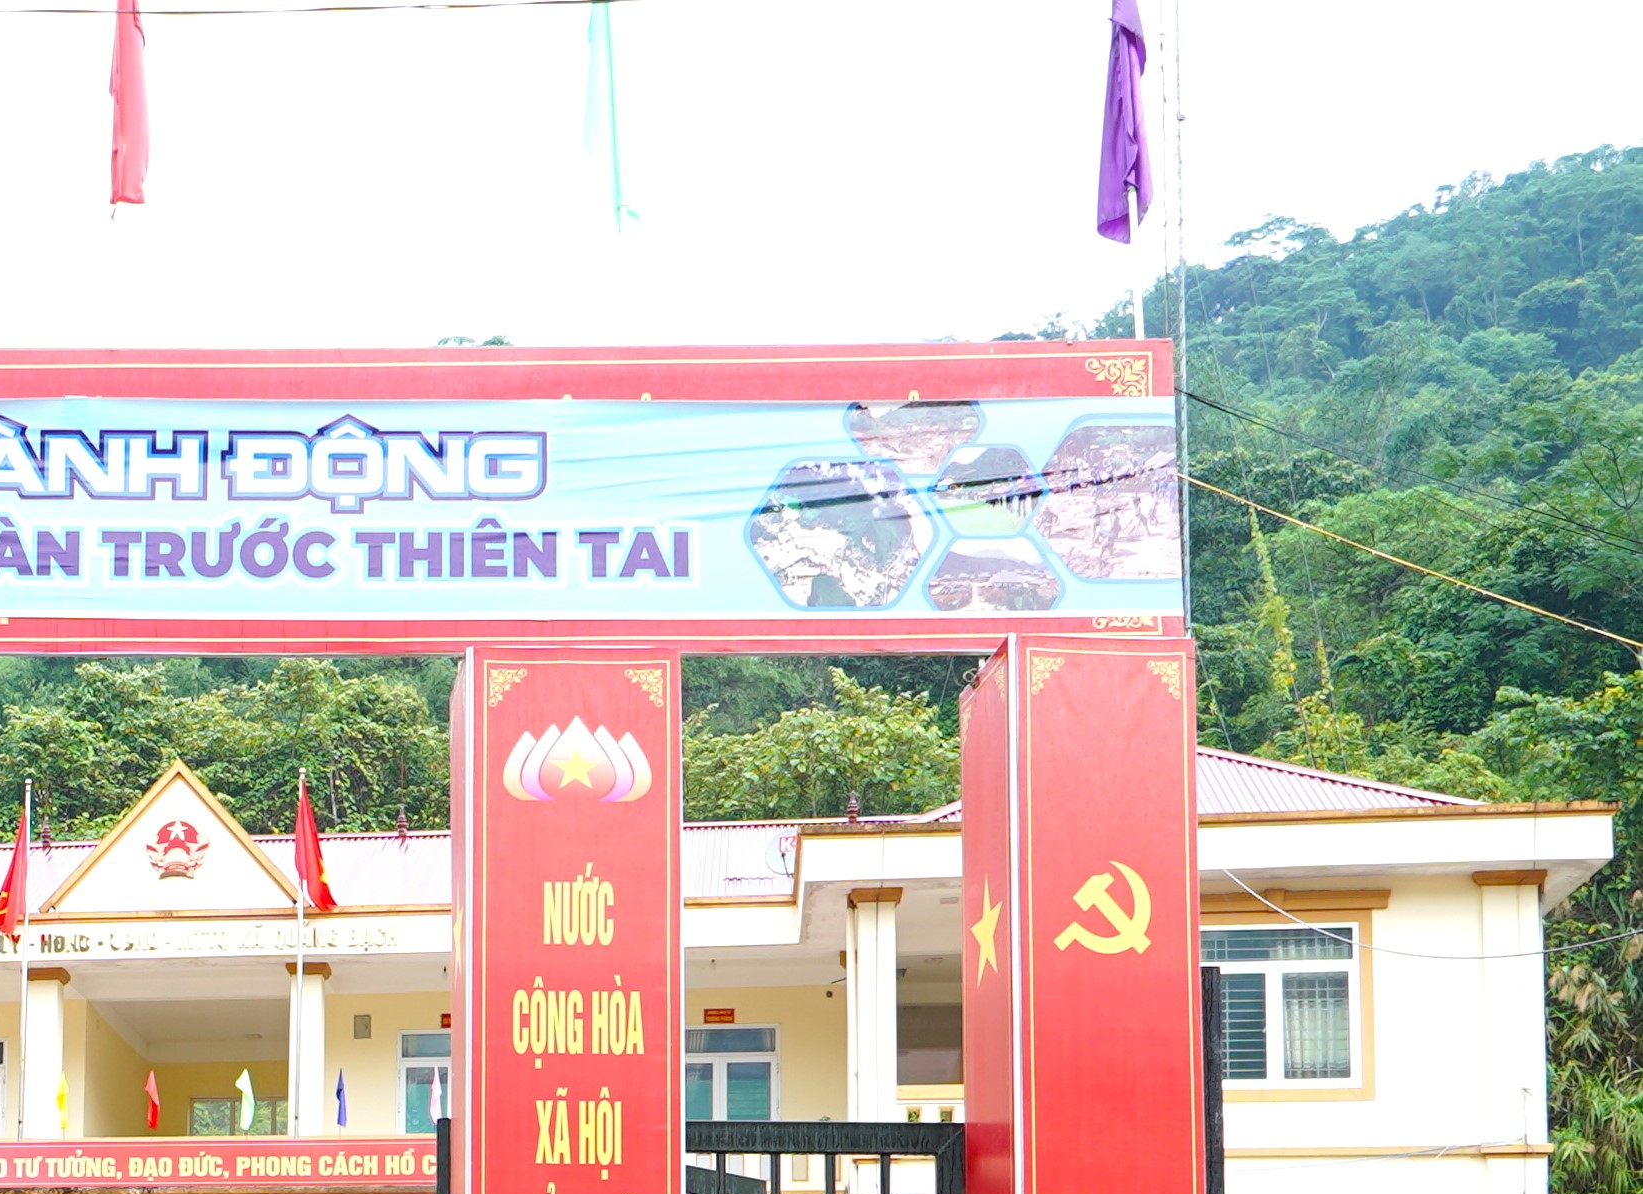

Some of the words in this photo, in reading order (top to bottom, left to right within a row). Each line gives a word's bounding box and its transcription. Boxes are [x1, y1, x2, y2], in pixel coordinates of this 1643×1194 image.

[228, 414, 547, 514] ĐỘNG
[102, 519, 337, 579] TRƯỚC
[356, 519, 557, 578] THIÊN
[579, 530, 690, 578] TAI
[543, 862, 615, 946] NƯỚC
[512, 976, 584, 1069] CỘNG
[591, 974, 645, 1056] HÒA
[14, 1156, 43, 1179] TƯ
[46, 1149, 122, 1180] TƯỞNG,
[128, 1156, 173, 1182] ĐẠO
[178, 1151, 229, 1179] ĐỨC,
[236, 1155, 312, 1177] PHONG
[318, 1151, 381, 1177] CÁCH
[385, 1148, 416, 1176] HỒ
[535, 1087, 571, 1165] XÃ
[579, 1086, 622, 1180] HỘI
